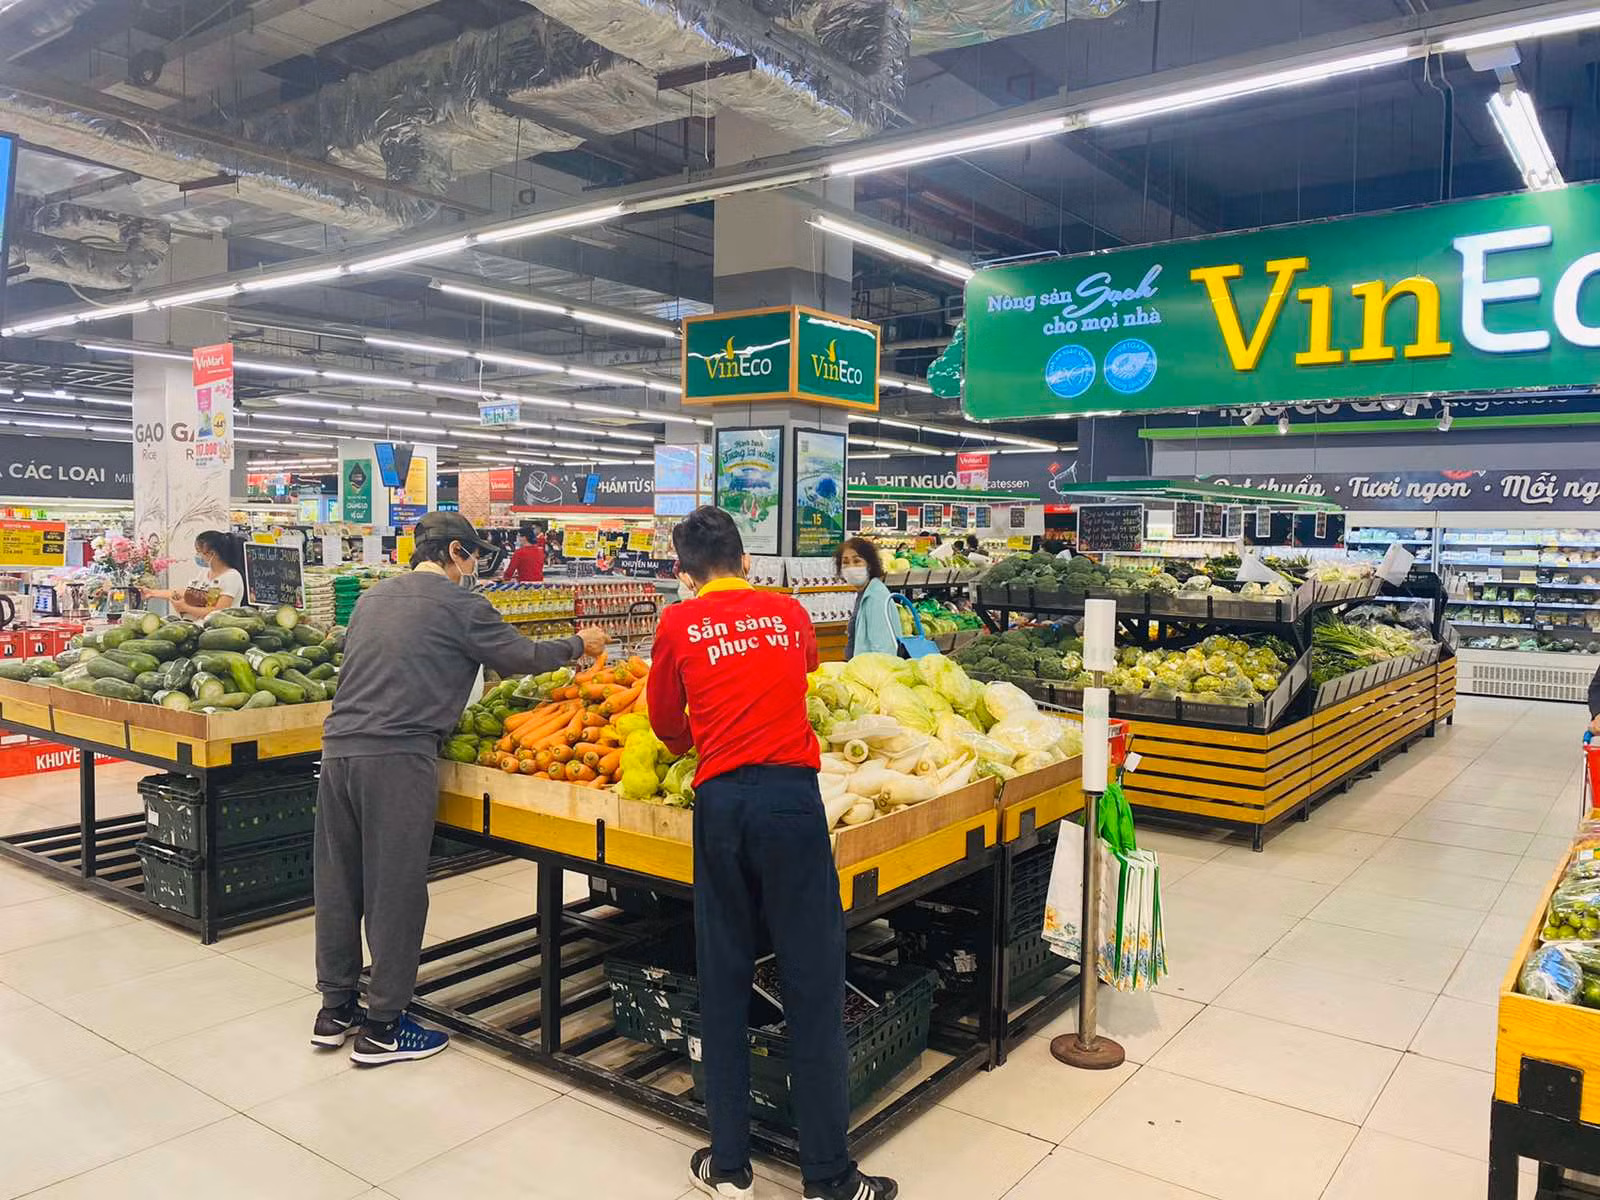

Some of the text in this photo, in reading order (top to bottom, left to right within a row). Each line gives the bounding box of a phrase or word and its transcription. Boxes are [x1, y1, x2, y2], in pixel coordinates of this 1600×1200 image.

[987, 264, 1163, 318] Nông sản Sạch
[1043, 306, 1162, 335] cho mọi nhà
[195, 355, 225, 371] VinMart
[704, 354, 773, 380] VinEco
[811, 353, 863, 385] VinEco
[135, 423, 164, 447] GẠO
[143, 448, 158, 460] Rice
[8, 459, 53, 479] CÁC
[58, 466, 105, 485] LOẠI
[986, 478, 1030, 489] catessen
[1348, 475, 1402, 498] Tươi
[1405, 482, 1471, 504] ngon
[1501, 472, 1559, 504] Mỗi
[1563, 482, 1600, 504] ng
[812, 513, 822, 525] 15
[687, 614, 787, 643] Sẵn sàng
[707, 635, 760, 666] phục
[765, 633, 790, 651] vụ
